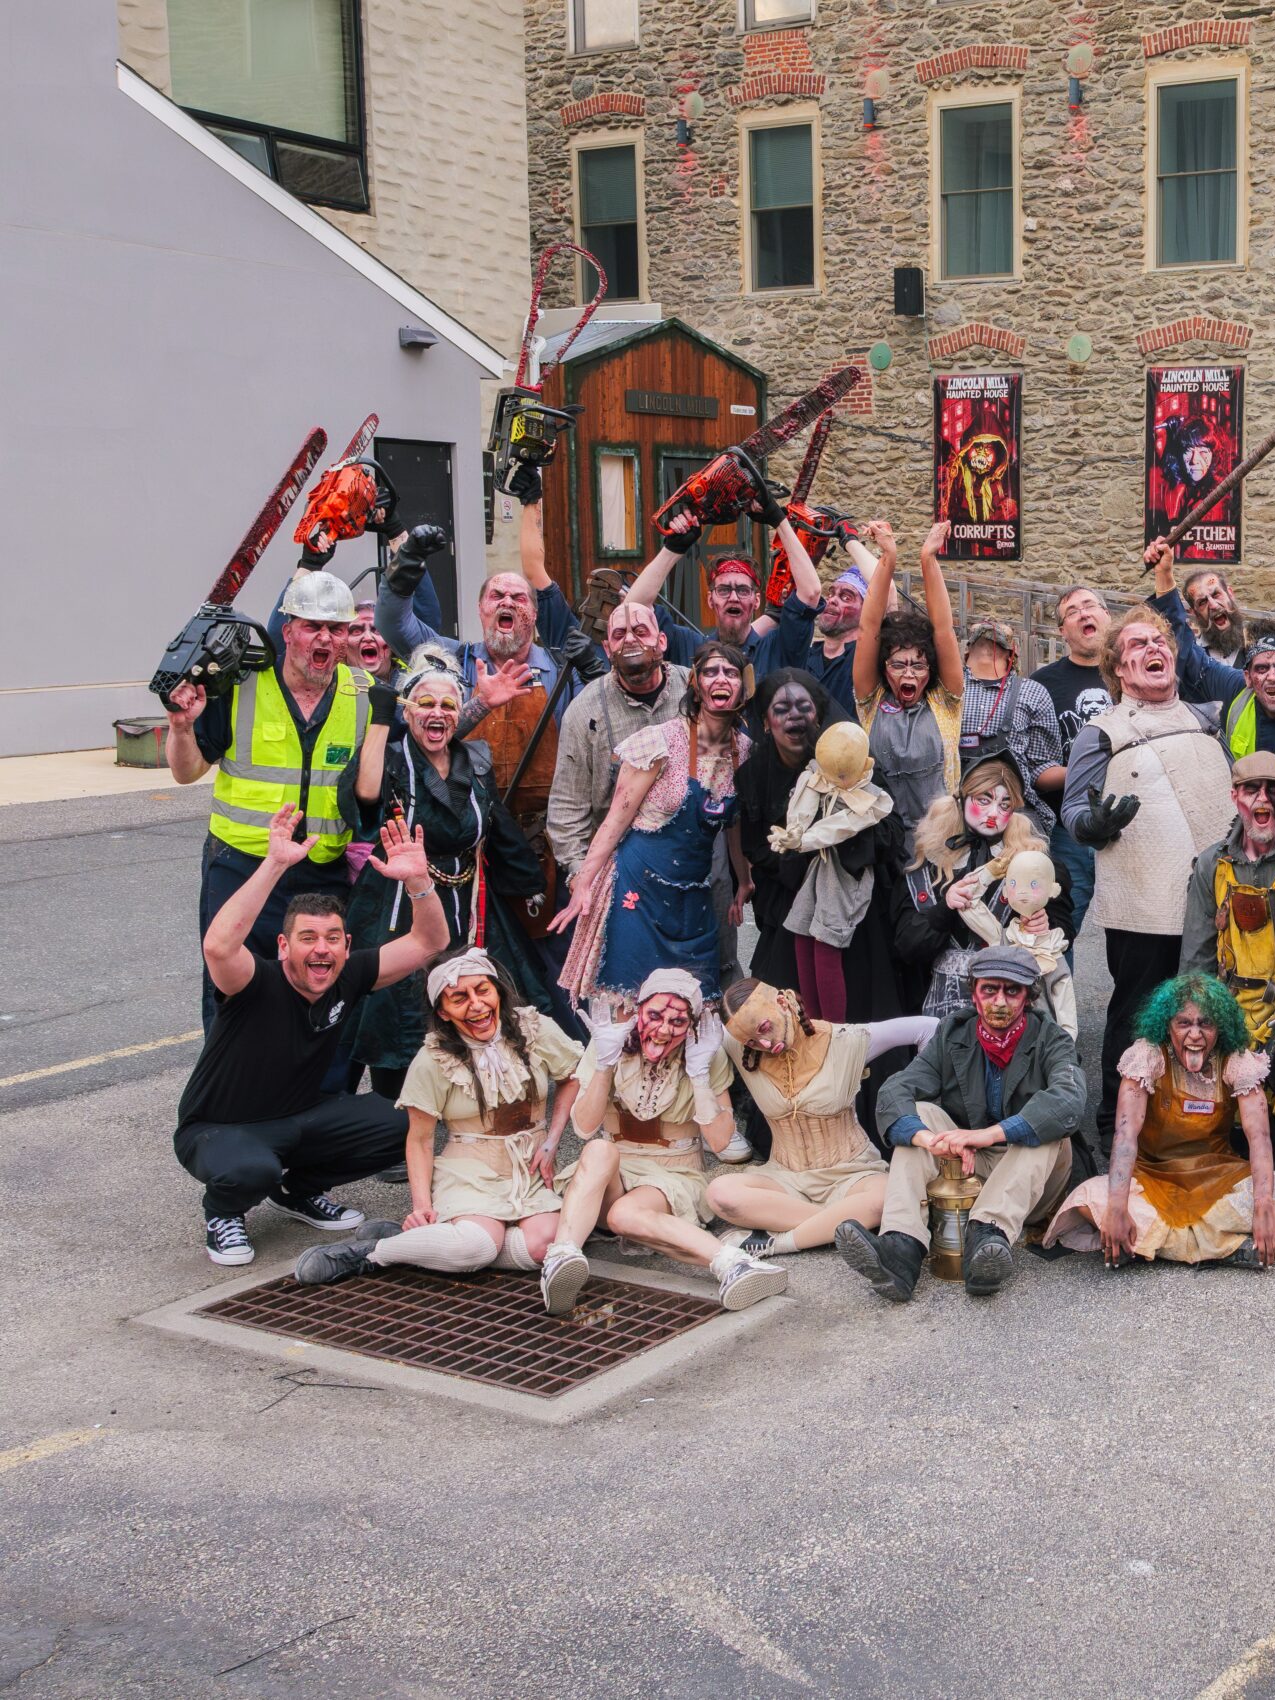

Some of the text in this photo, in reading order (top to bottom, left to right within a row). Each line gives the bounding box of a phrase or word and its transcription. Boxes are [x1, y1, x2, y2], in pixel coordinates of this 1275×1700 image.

[947, 376, 1008, 390] LINCOLN MILL
[1161, 369, 1229, 383] LINCOLN MILL
[946, 389, 1008, 399] HAUNTED HOUSE
[1160, 382, 1230, 393] HAUNTED HOUSE
[638, 393, 681, 412] LINCOLN
[953, 524, 1015, 539] CORRUPTIS
[1170, 525, 1236, 541] ETCHEN
